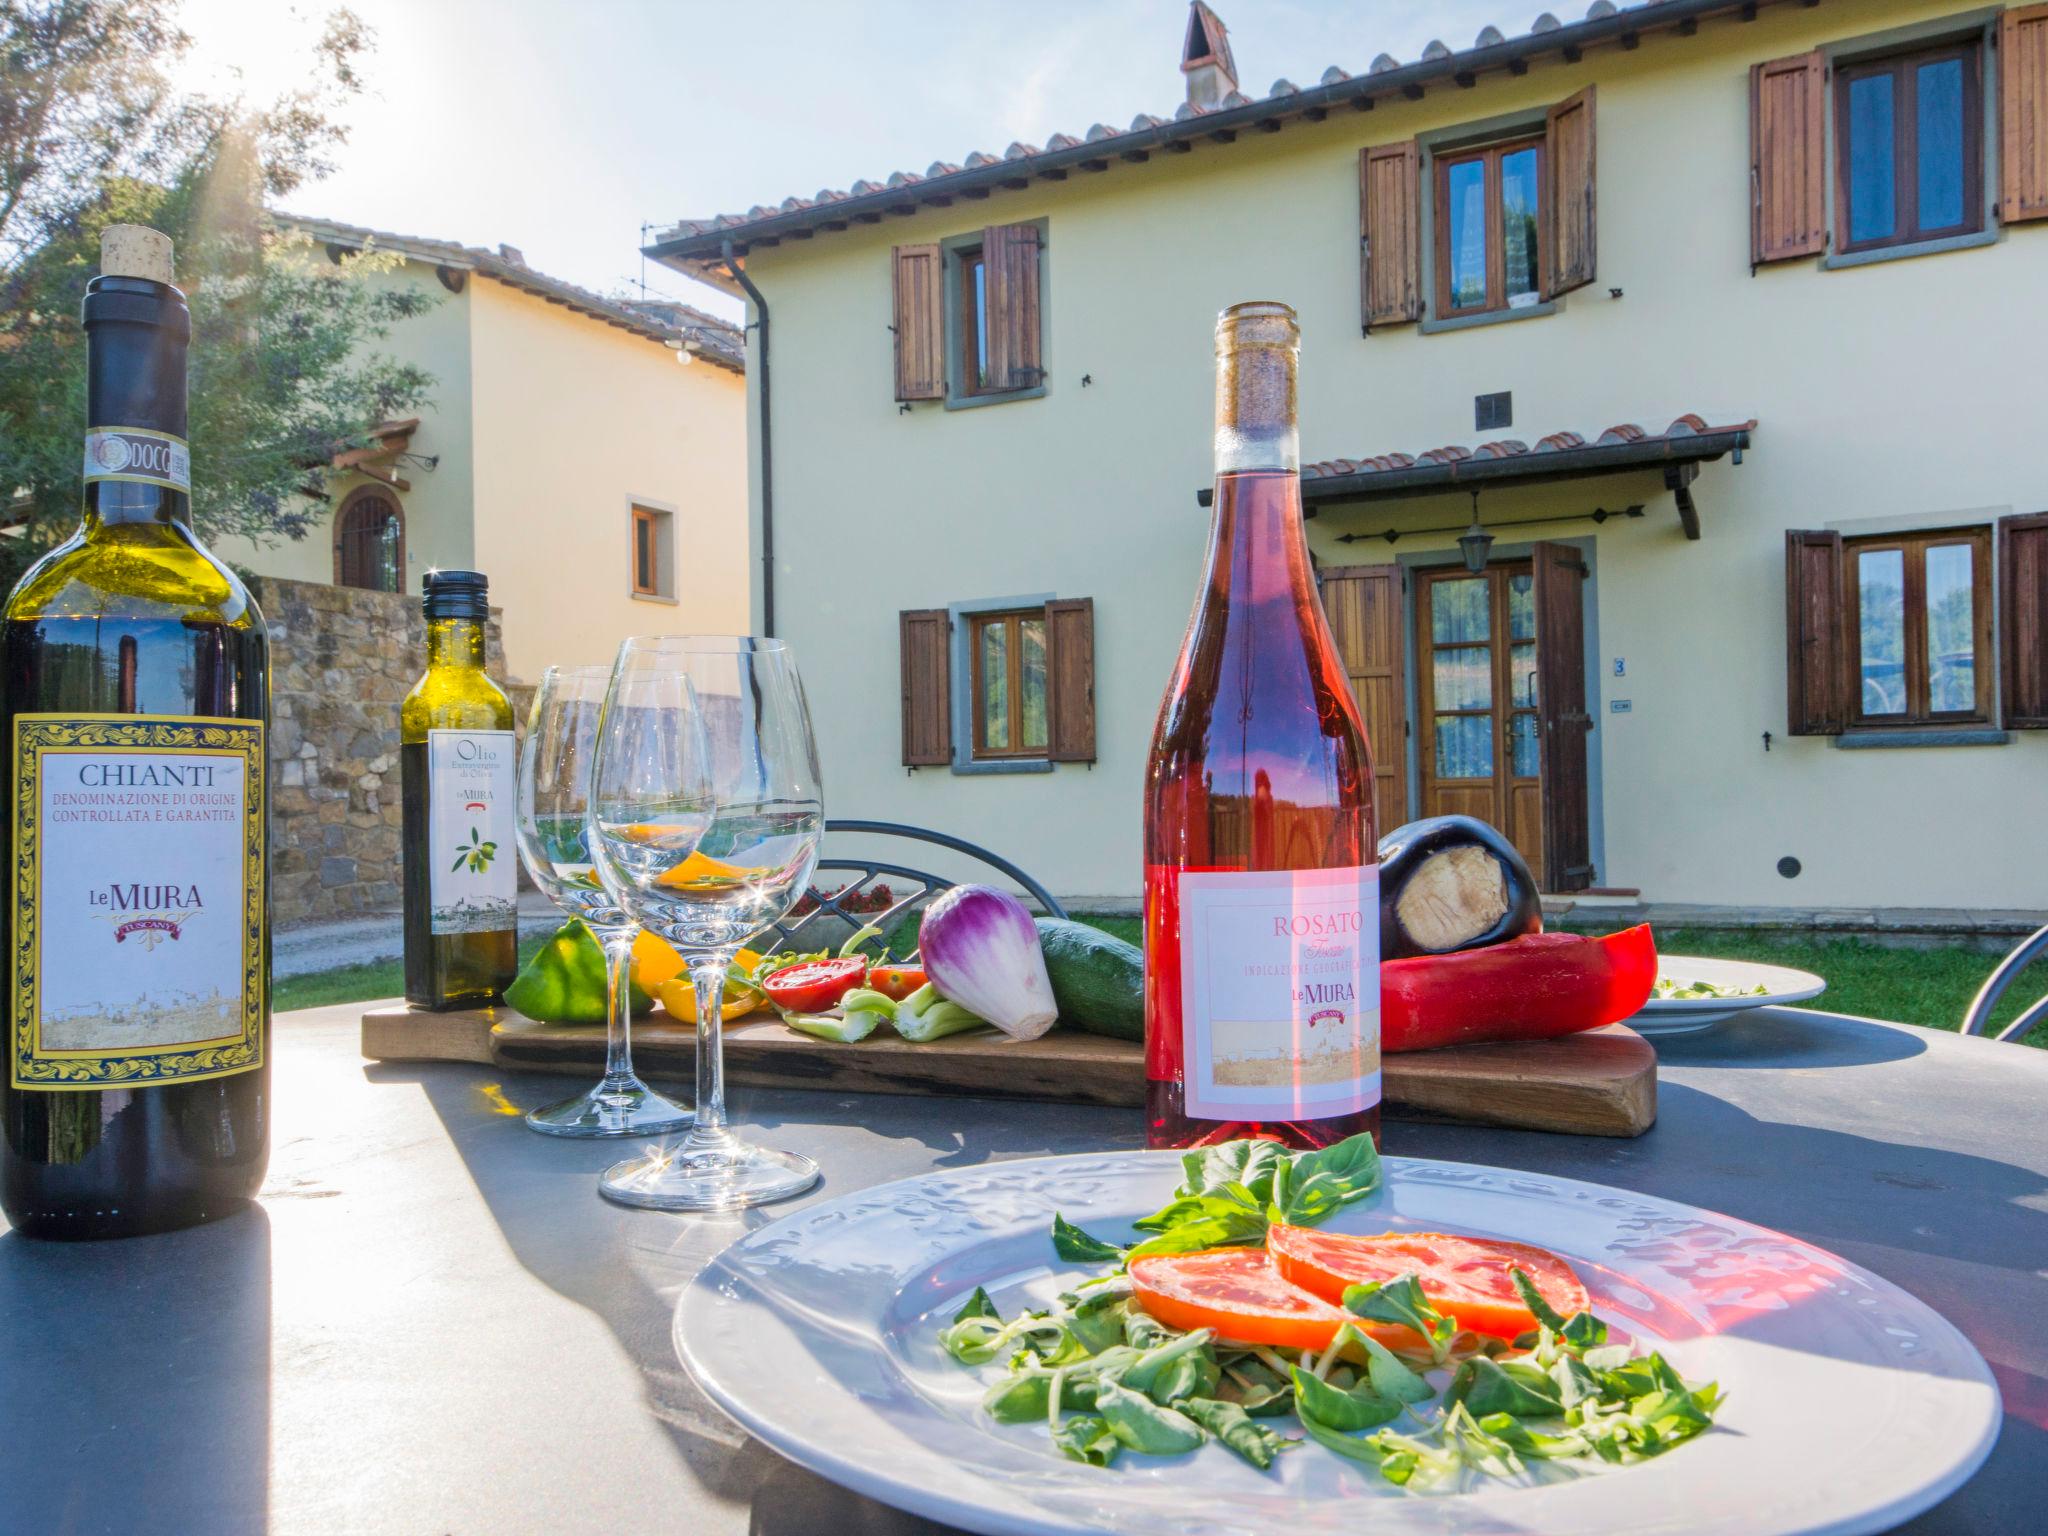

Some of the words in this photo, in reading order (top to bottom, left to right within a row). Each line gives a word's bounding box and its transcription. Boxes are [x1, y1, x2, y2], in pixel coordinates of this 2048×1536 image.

[131, 442, 170, 473] DOCG
[79, 764, 215, 787] CHIANTI
[52, 793, 168, 806] DENOMINAZIONE
[172, 794, 186, 805] DI
[190, 794, 236, 806] ORIGINE
[52, 810, 149, 822] CONTROLLATA
[155, 810, 162, 822] E
[166, 809, 236, 822] GARANTITA
[90, 890, 108, 905] Le
[110, 883, 203, 910] MURA
[124, 920, 175, 932] TUSCANY
[1273, 911, 1363, 937] ROSATO
[1304, 982, 1355, 1004] MURA
